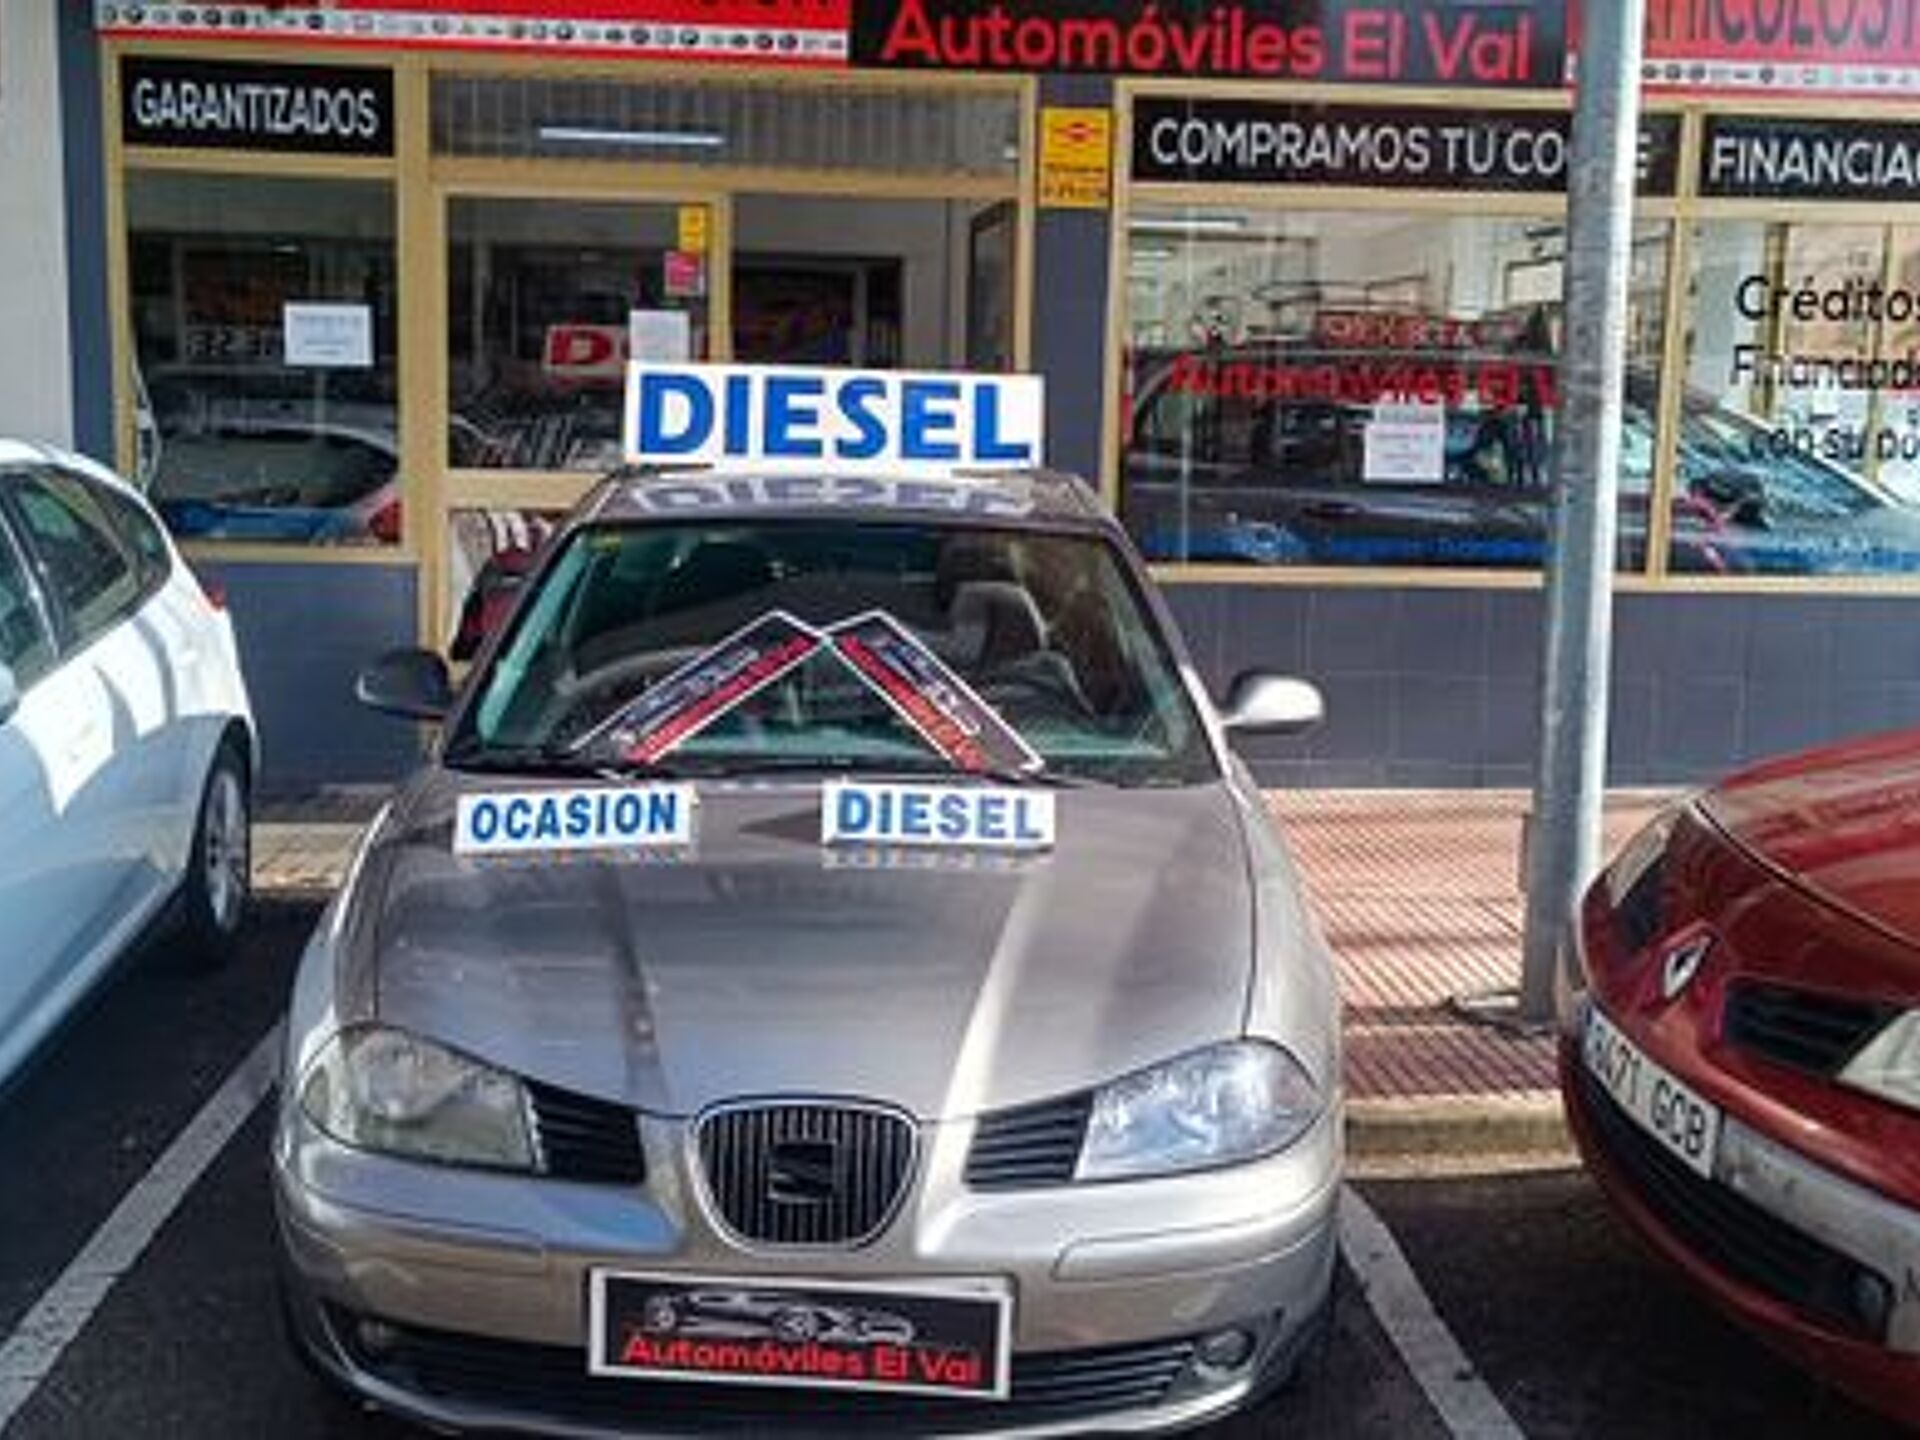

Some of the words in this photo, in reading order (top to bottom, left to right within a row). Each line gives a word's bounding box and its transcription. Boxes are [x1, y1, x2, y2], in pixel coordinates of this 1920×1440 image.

[882, 0, 1325, 76] Automóviles
[1343, 12, 1400, 79] El
[1424, 13, 1531, 81] Val
[132, 78, 379, 138] GARANTIZADOS
[1151, 117, 1431, 173] COMPRAMOS
[1440, 127, 1495, 175] TU
[1710, 135, 1920, 187] FINANCIA
[1735, 275, 1920, 321] Crédito
[1730, 344, 1920, 390] Financiad
[639, 374, 1031, 461] DIESEL
[471, 792, 677, 843] OCASION
[836, 787, 1043, 840] DIESEL
